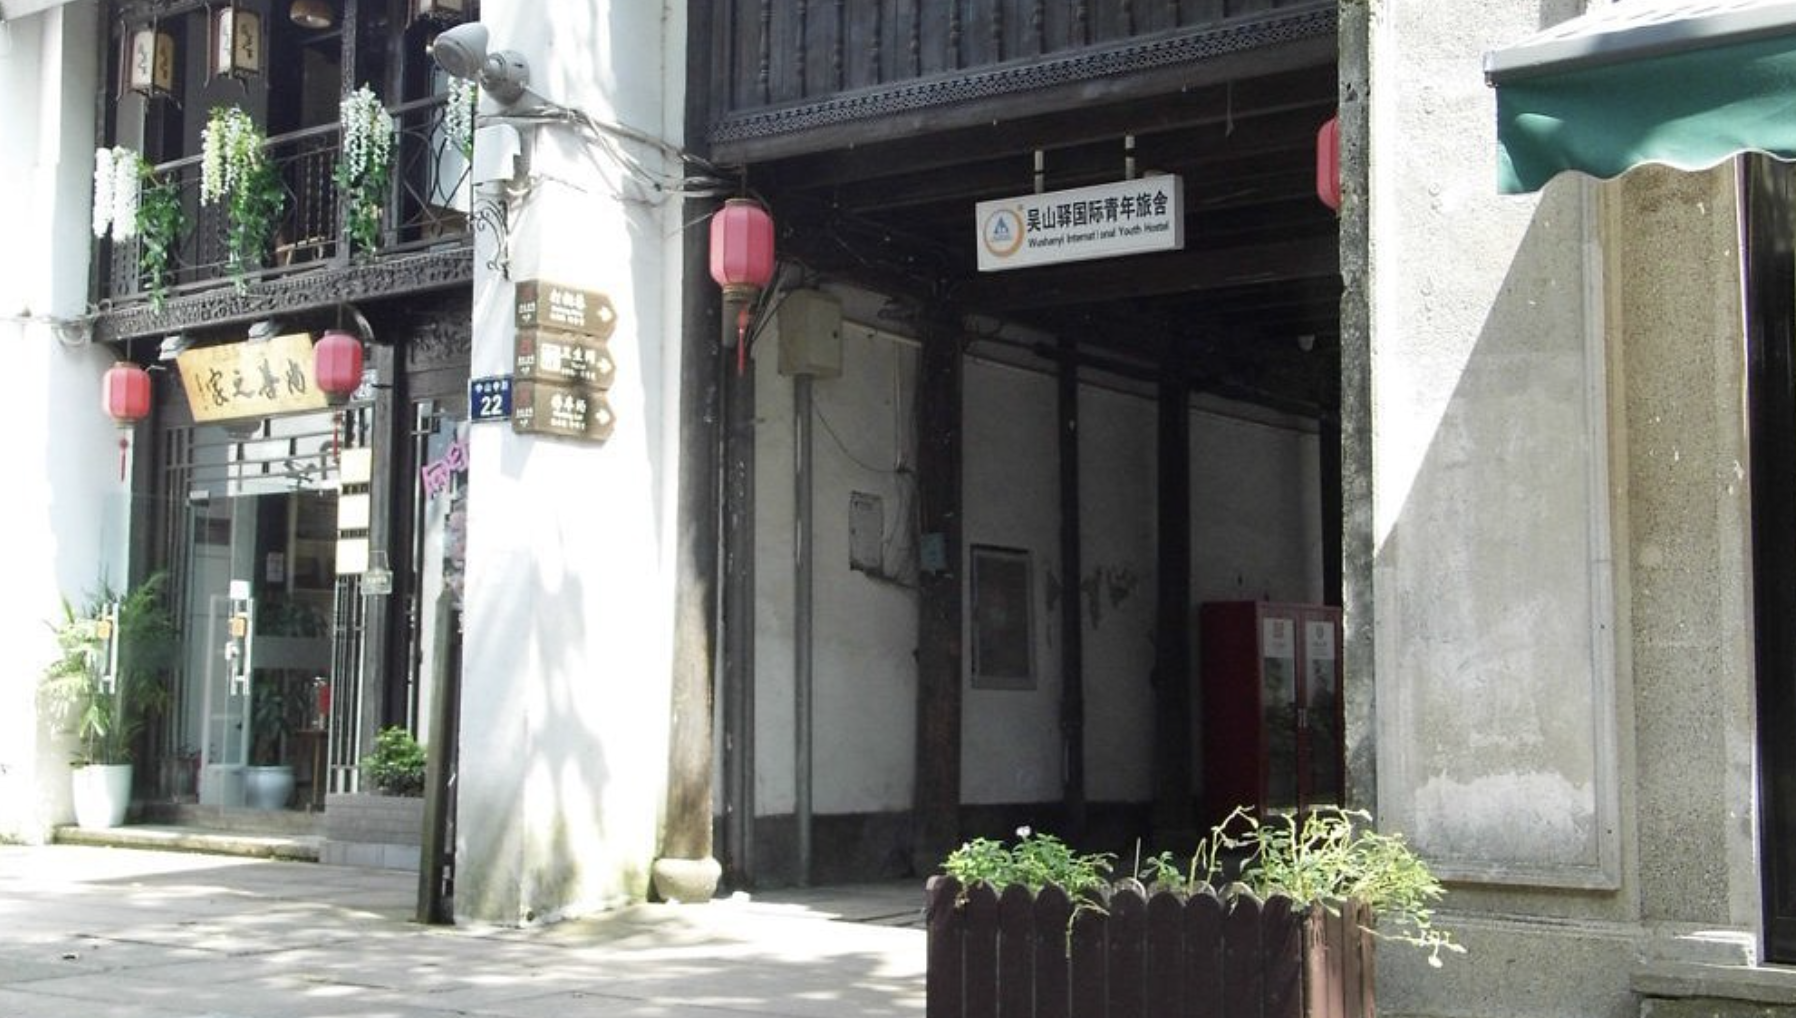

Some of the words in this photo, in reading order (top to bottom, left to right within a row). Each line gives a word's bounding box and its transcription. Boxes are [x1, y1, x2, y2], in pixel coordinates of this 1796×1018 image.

[1027, 190, 1168, 232] 吴山驿国际青年旅舍
[1028, 236, 1065, 248] Wushanyi
[1119, 224, 1142, 237] Youth
[1144, 220, 1169, 233] Hostel
[480, 394, 503, 416] 22
